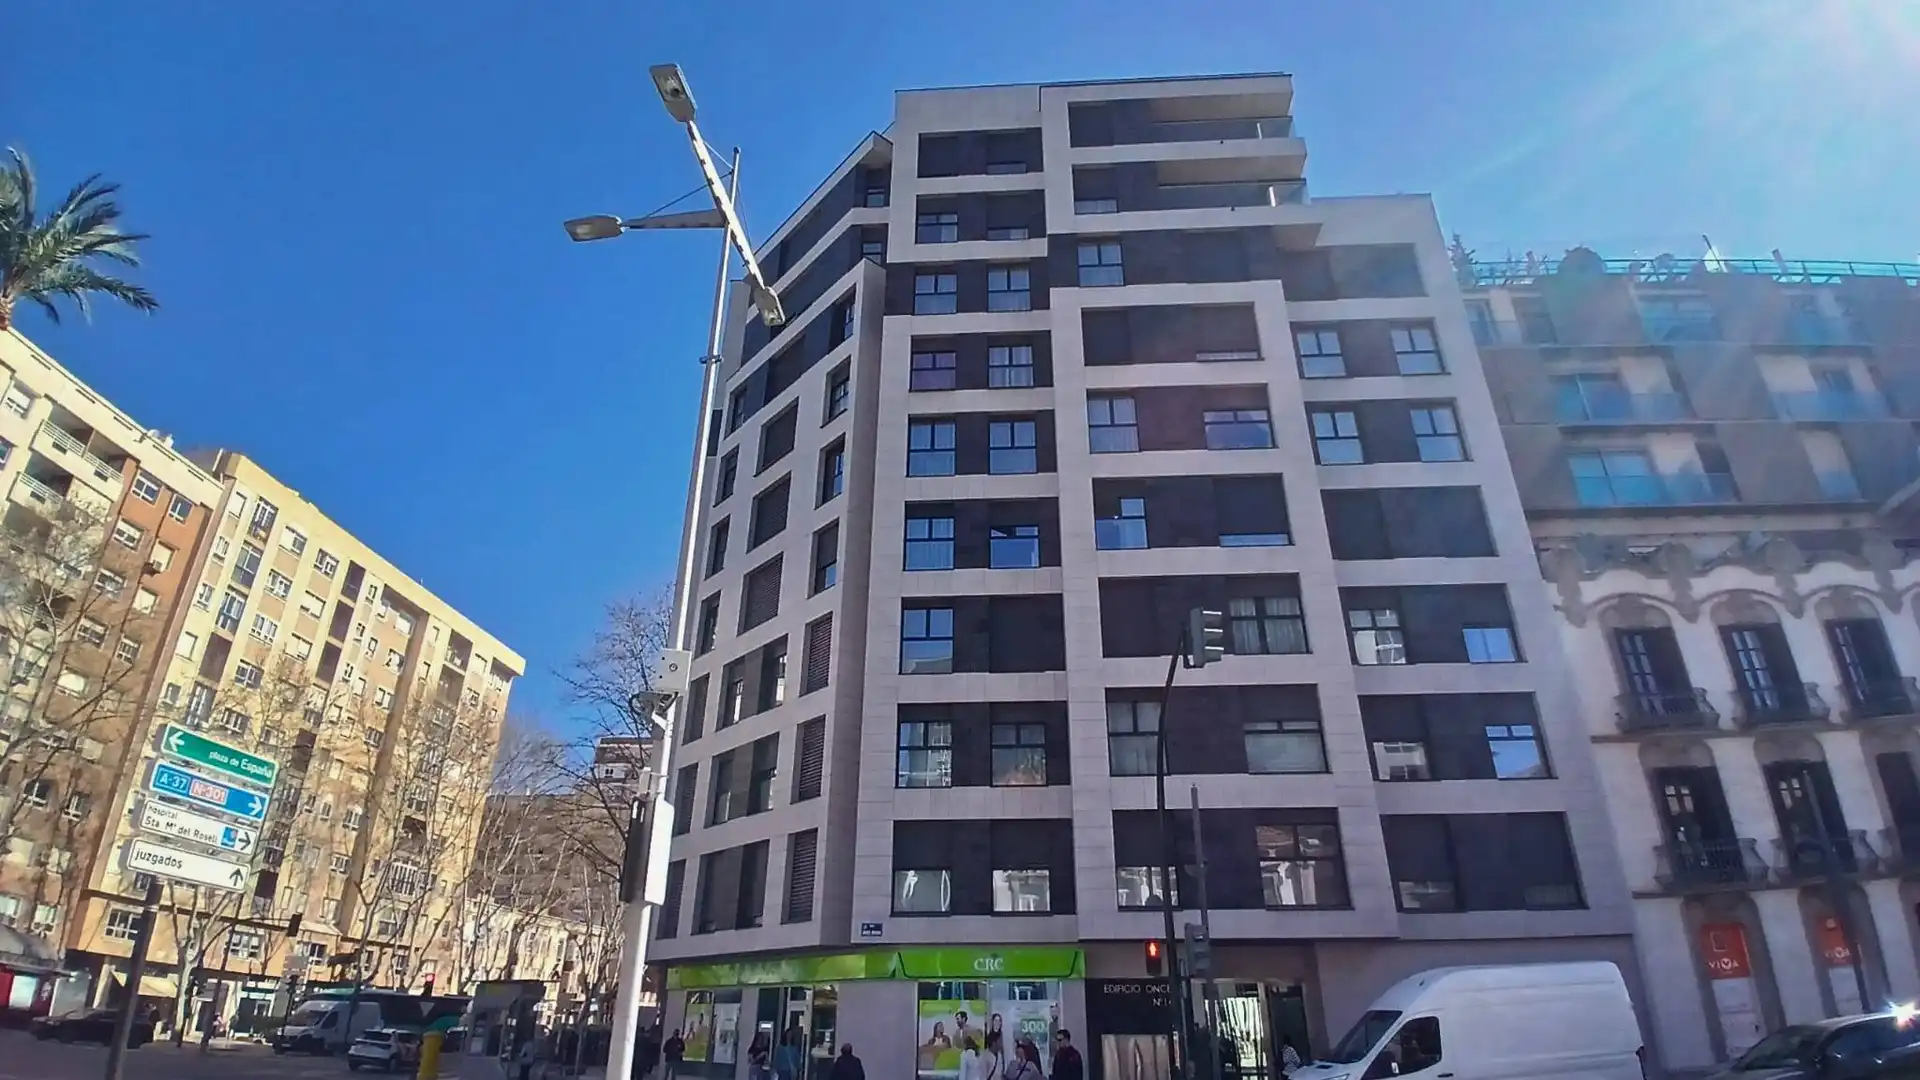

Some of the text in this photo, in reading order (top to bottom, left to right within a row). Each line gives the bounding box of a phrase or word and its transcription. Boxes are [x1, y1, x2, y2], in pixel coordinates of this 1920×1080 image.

[159, 772, 188, 790] A-37
[192, 781, 227, 803] N-301
[134, 849, 183, 870] juzgados
[973, 957, 1005, 972] CRC
[1103, 983, 1141, 994] EDIFICIO
